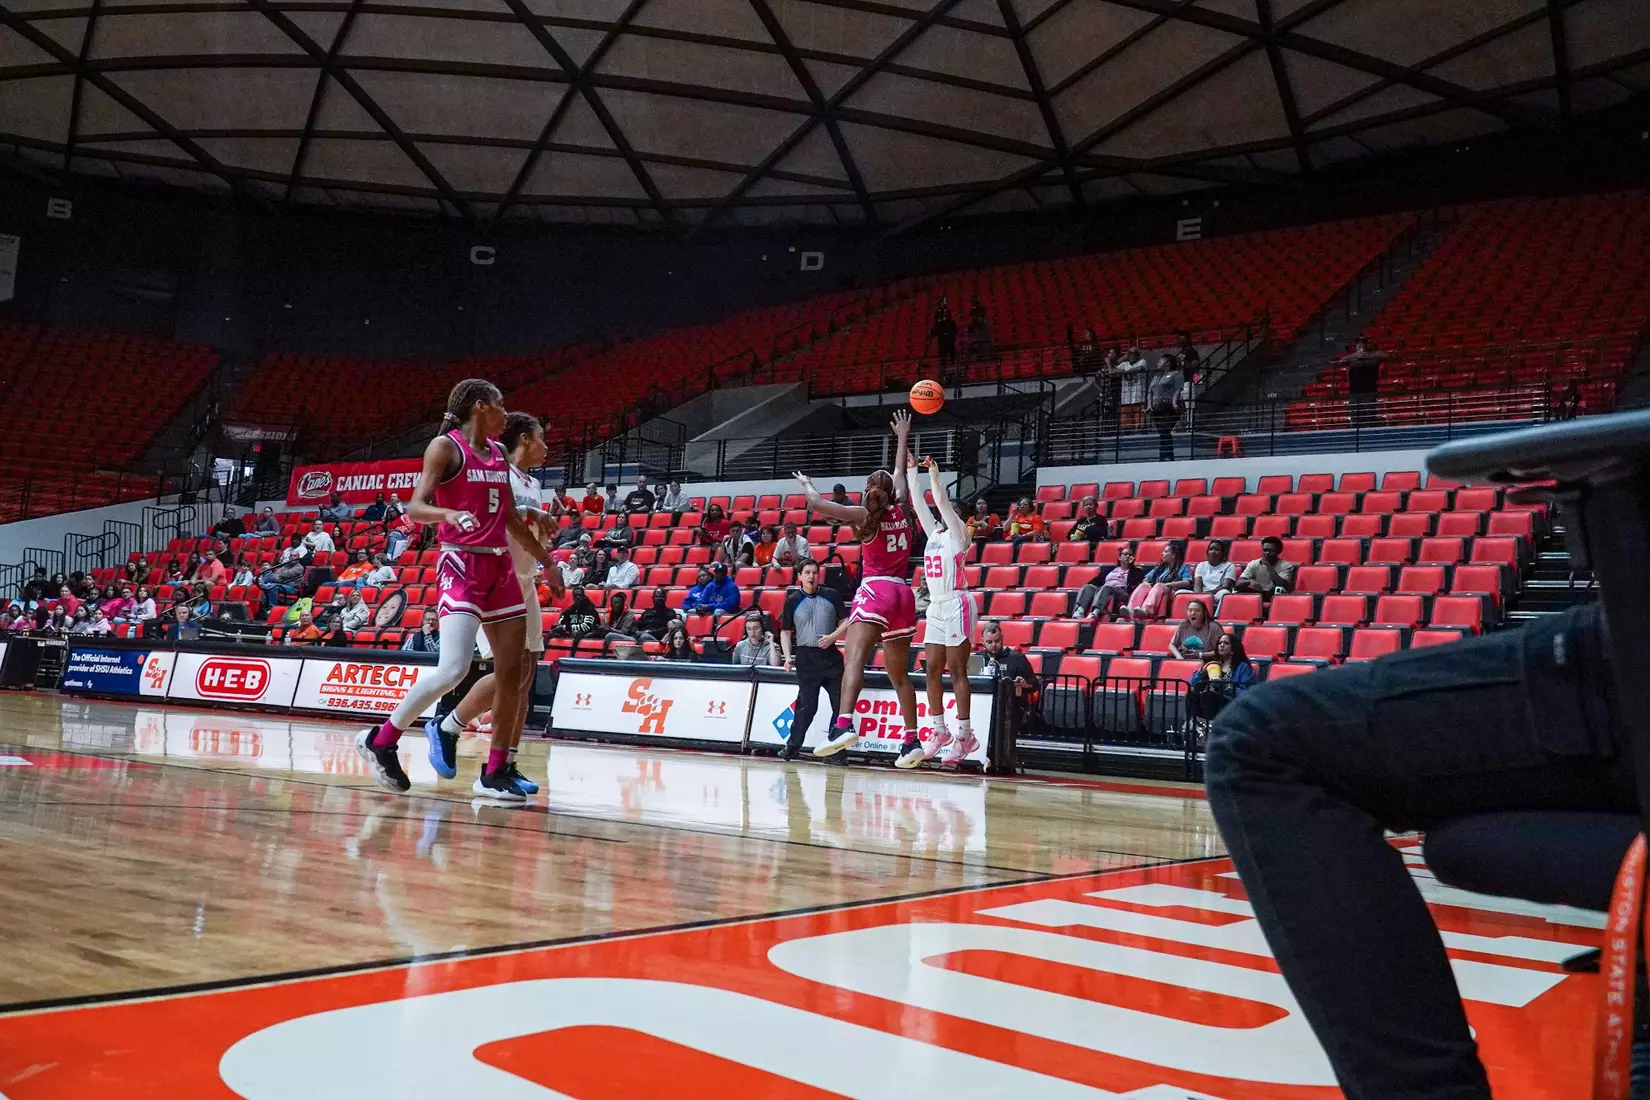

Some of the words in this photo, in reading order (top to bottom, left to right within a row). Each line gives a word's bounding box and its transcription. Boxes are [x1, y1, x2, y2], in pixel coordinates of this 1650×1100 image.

[47, 198, 73, 219] B
[1176, 217, 1202, 241] E
[470, 246, 496, 265] C
[800, 251, 824, 271] D
[336, 474, 385, 491] CANIAC
[466, 469, 486, 483] SAM
[488, 488, 499, 513] 5
[886, 533, 908, 552] 24
[924, 556, 943, 578] 23
[71, 653, 81, 661] The
[81, 654, 100, 662] Official
[100, 655, 121, 663] Internet
[67, 664, 89, 672] provider
[95, 665, 110, 674] SHSU
[109, 666, 133, 675] Athletics
[327, 663, 419, 687] ARTECH
[320, 685, 346, 693] SIGNS
[347, 686, 354, 694] &
[327, 698, 399, 712] 936.435.996
[859, 717, 934, 742] Piza
[864, 741, 888, 751] Online
[1607, 937, 1627, 1005] STATE
